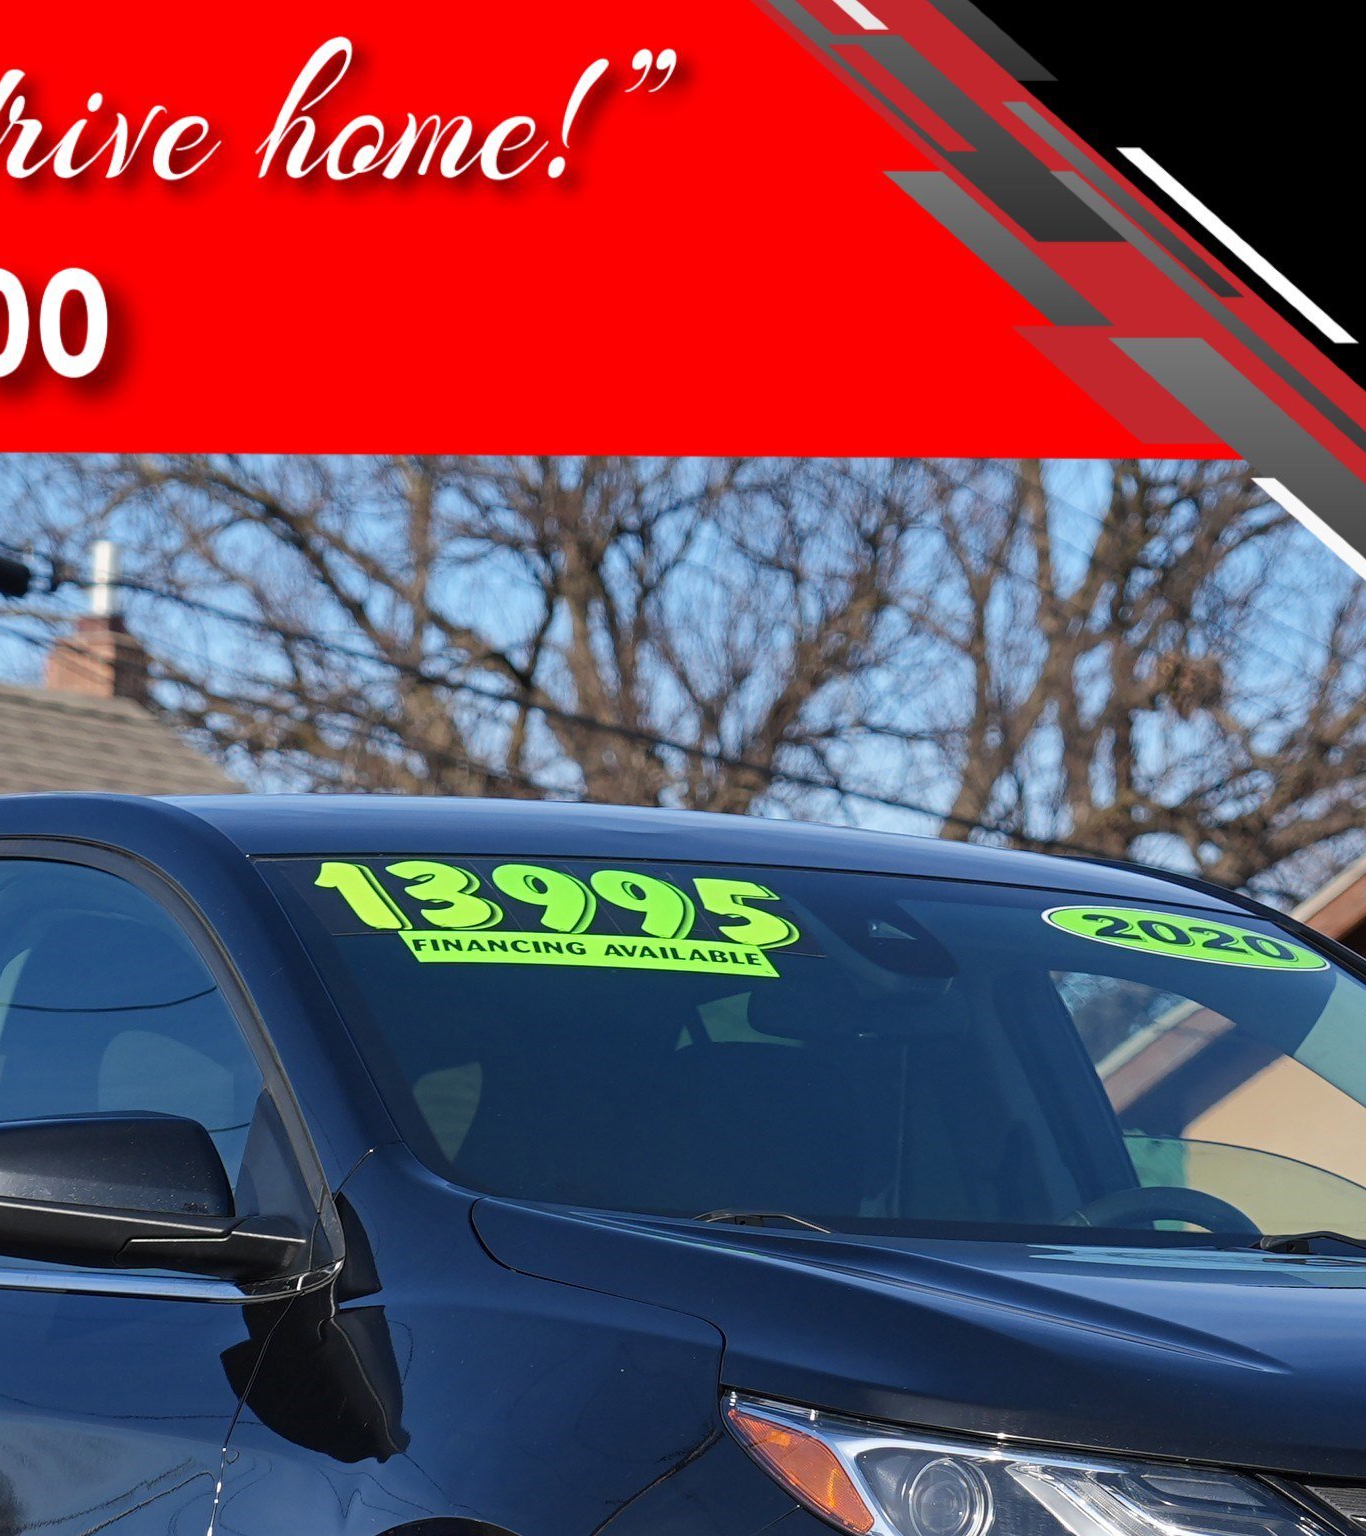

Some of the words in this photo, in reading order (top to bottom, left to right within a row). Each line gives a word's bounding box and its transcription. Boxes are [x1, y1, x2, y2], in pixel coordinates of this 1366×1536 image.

[313, 860, 801, 950] 13995
[412, 937, 587, 958] FINANCING
[603, 943, 763, 967] AVAILABLE
[1081, 913, 1299, 963] 2020
